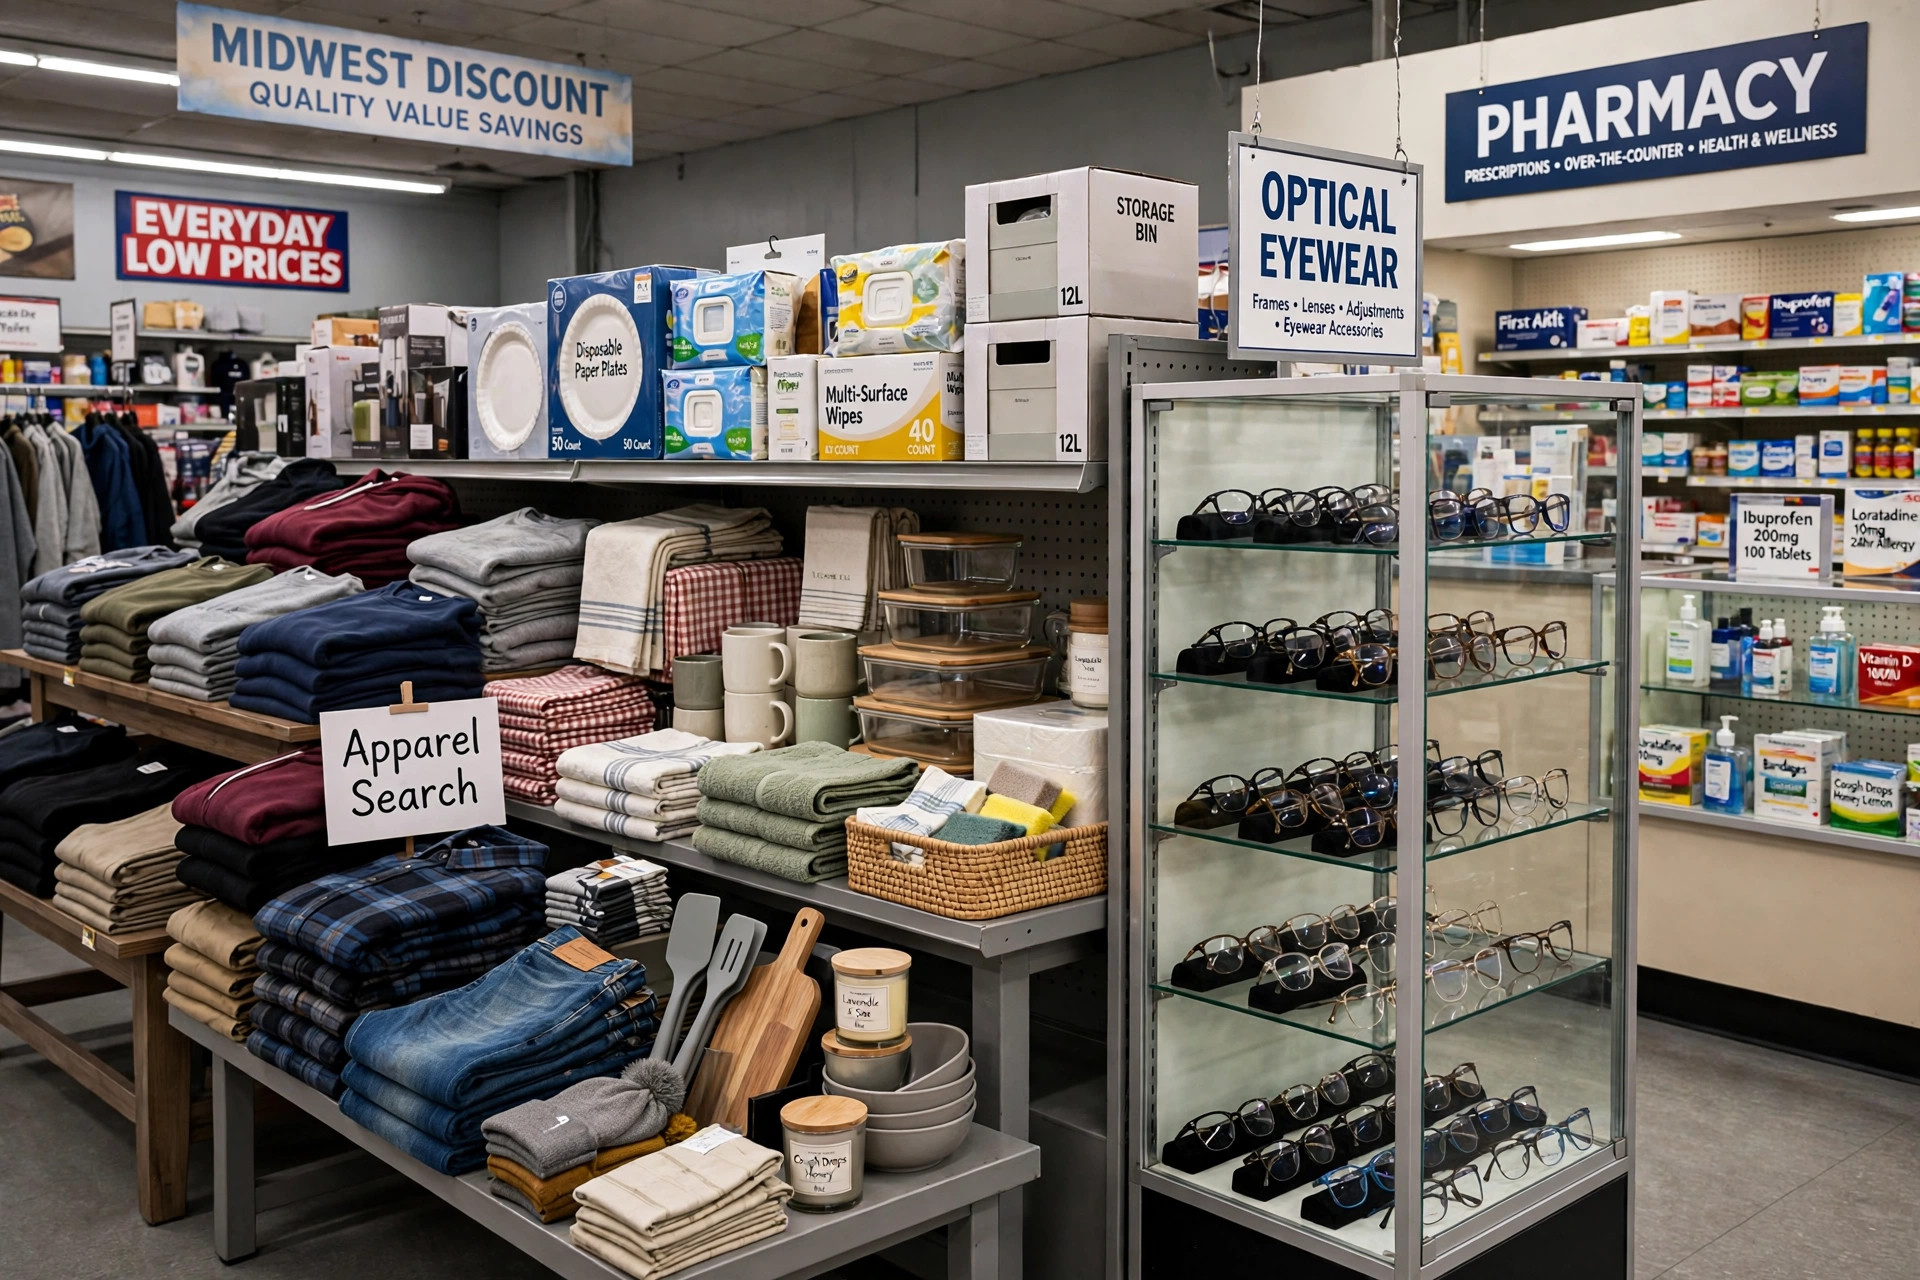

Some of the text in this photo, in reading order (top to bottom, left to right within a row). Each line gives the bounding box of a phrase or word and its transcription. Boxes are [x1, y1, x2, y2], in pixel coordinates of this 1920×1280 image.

[212, 22, 610, 119] MIDWEST DISCOUNT
[249, 81, 584, 146] QUALITY VALUE SAVINGS
[1477, 51, 1828, 158] PHARMACY
[1465, 122, 1838, 184] PRESCRIPTIONS OVER-THE-COUNTER HEALTH & WELLNESS
[1117, 196, 1175, 223] STORAGE
[1262, 170, 1397, 235] OPTICAL
[135, 201, 330, 248] EVERYDAY
[1135, 223, 1158, 243] BIN
[126, 237, 342, 285] LOW PRICES
[1260, 233, 1399, 289] EYEWEAR
[1061, 286, 1083, 306] 12L
[1253, 293, 1405, 321] Frames Lenses Adjustments
[1773, 294, 1832, 314] Ibuprofen
[1283, 317, 1384, 339] Eyewear Accessories
[1499, 315, 1531, 331] First
[576, 338, 622, 361] Disposable
[575, 360, 628, 382] Paper Plates
[826, 383, 908, 403] Multi-Surface
[826, 406, 863, 429] Wipes
[908, 418, 935, 443] 40
[552, 436, 581, 451] 50 Count
[623, 438, 632, 450] 50
[633, 438, 652, 450] Count
[835, 445, 860, 455] COUNT
[907, 444, 936, 455] COUNT
[1059, 434, 1082, 453] 12L
[1743, 510, 1813, 528] Ibuprofen
[1852, 508, 1918, 521] Loratadine
[1754, 529, 1799, 546] 200mg
[1744, 546, 1812, 561] 100 Tablets
[1902, 655, 1913, 667] D
[343, 716, 479, 777] Apparel
[351, 767, 478, 817] Search
[1866, 782, 1893, 798] Drops
